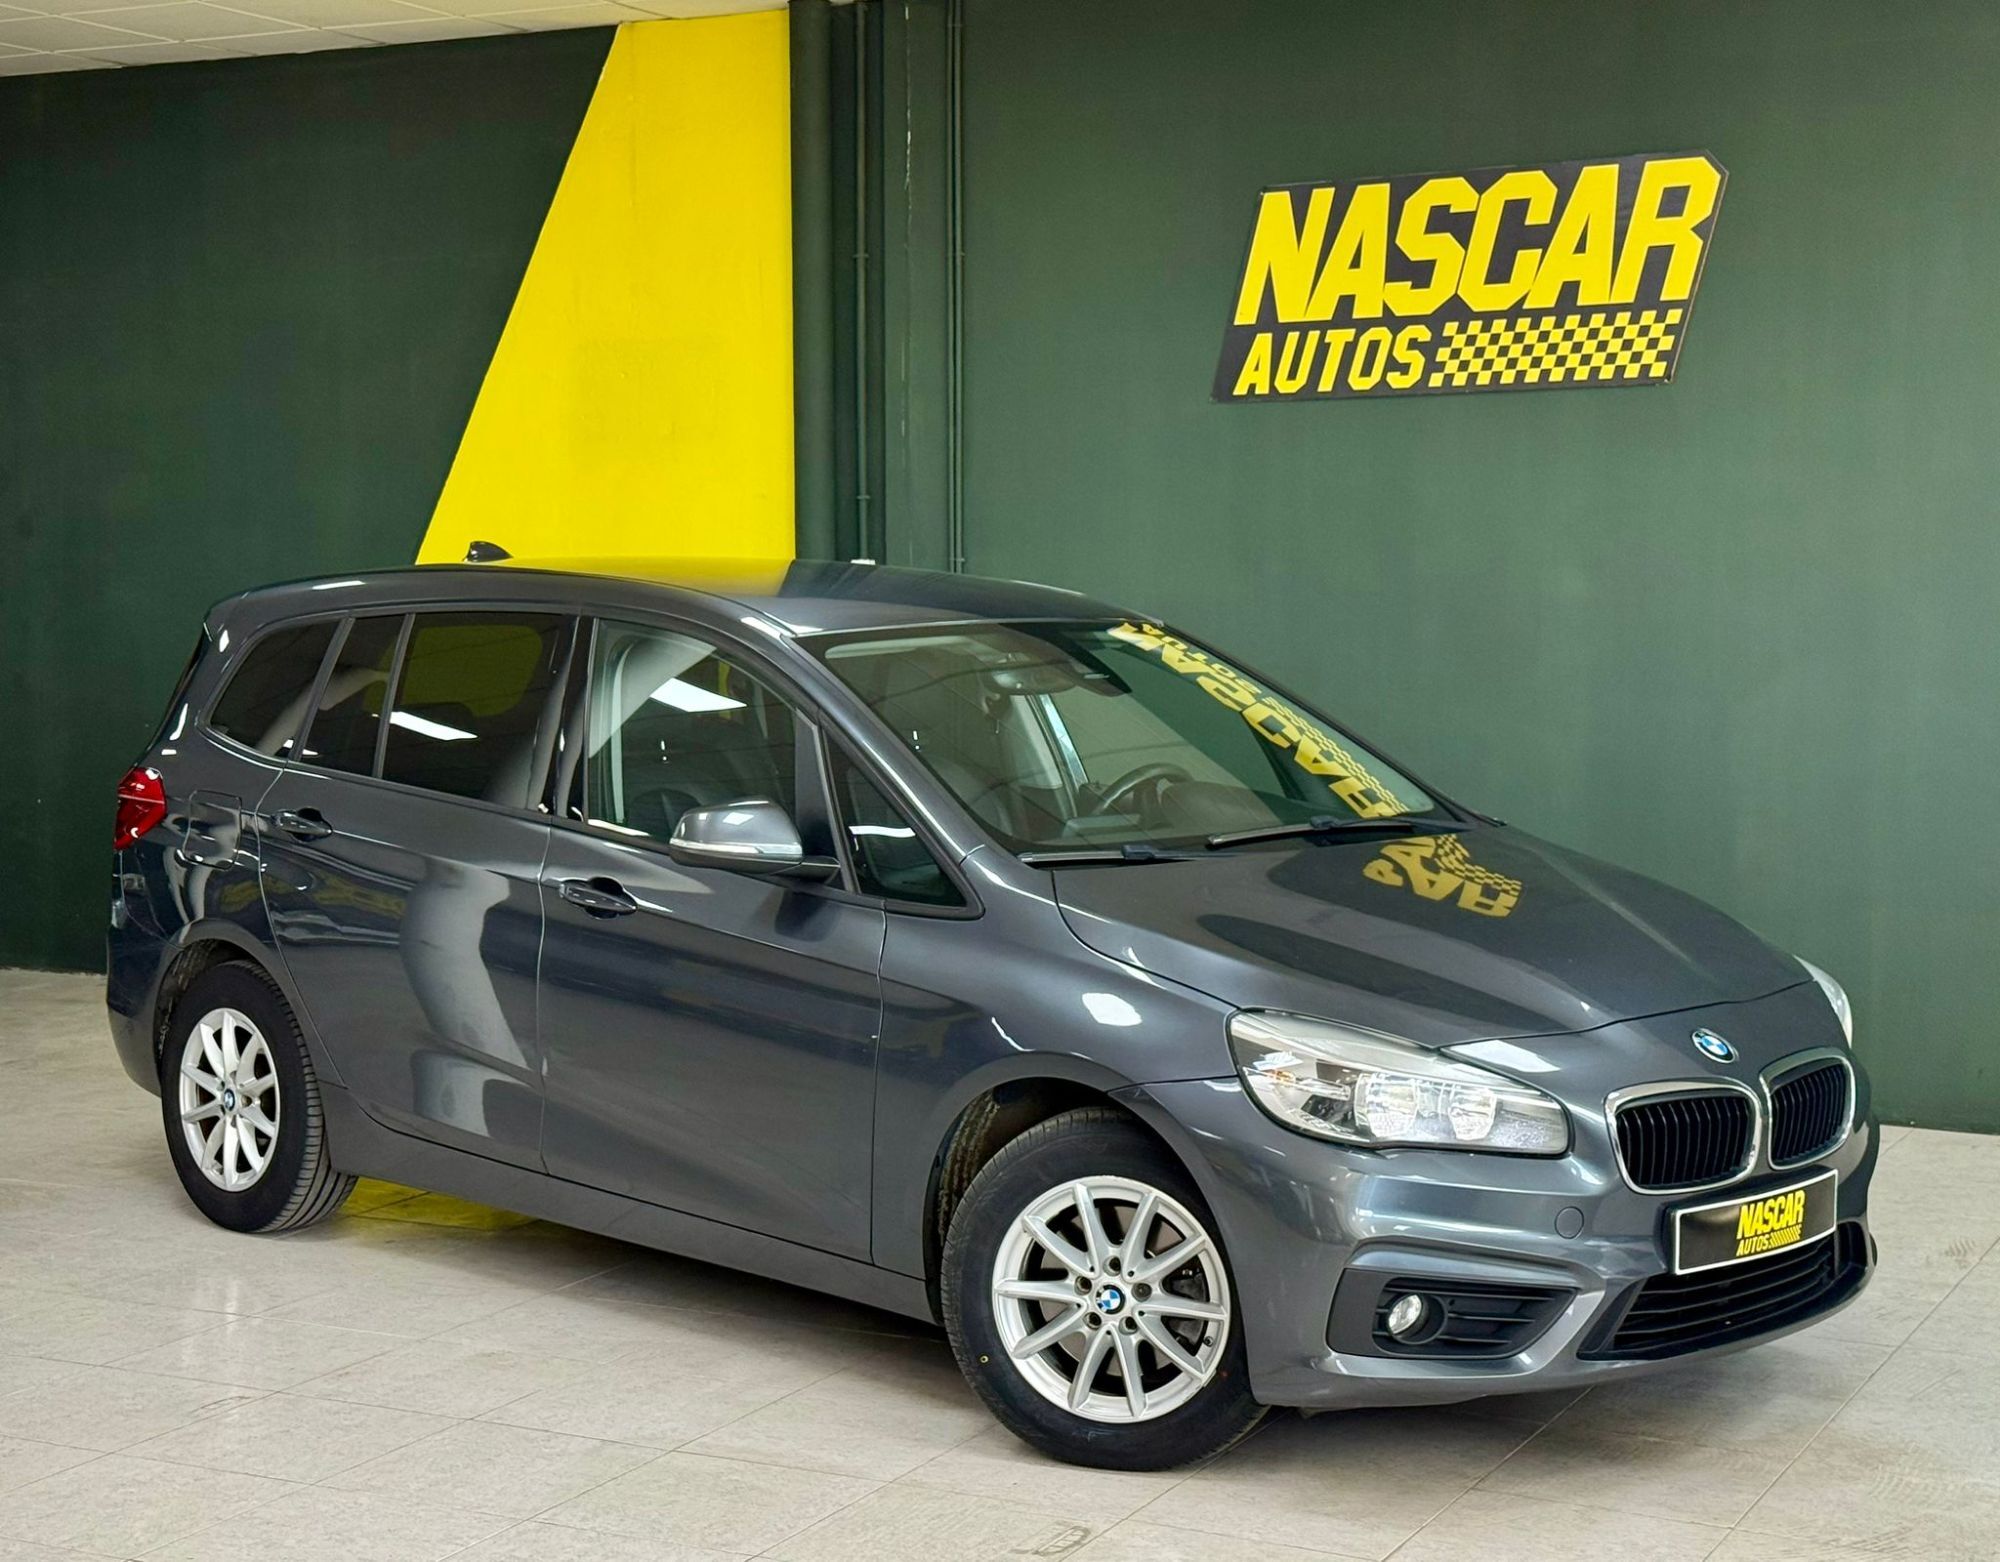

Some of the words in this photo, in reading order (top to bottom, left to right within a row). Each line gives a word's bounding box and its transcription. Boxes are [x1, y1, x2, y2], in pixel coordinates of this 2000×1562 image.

[1233, 156, 1721, 325] NASCAR
[1232, 325, 1432, 396] AUTOS
[1735, 1233, 1770, 1257] AUTOS
[1736, 1189, 1806, 1240] NASCAR
